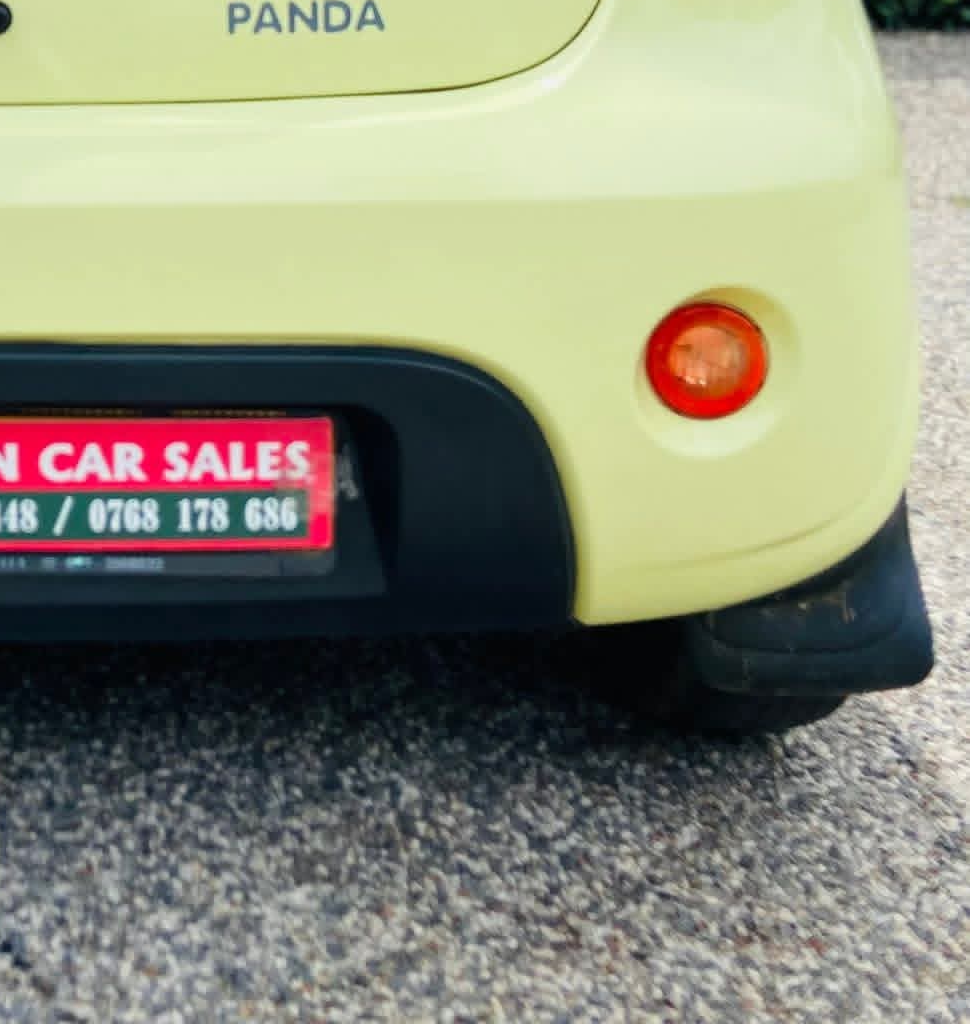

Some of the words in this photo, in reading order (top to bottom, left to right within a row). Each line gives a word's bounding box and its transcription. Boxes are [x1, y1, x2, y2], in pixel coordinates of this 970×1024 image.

[227, 0, 386, 35] PANDA
[38, 441, 148, 483] CAR
[162, 440, 311, 482] SALES
[52, 495, 74, 537] /
[88, 497, 160, 533] 0768
[177, 497, 230, 533] 178
[244, 496, 299, 533] 686
